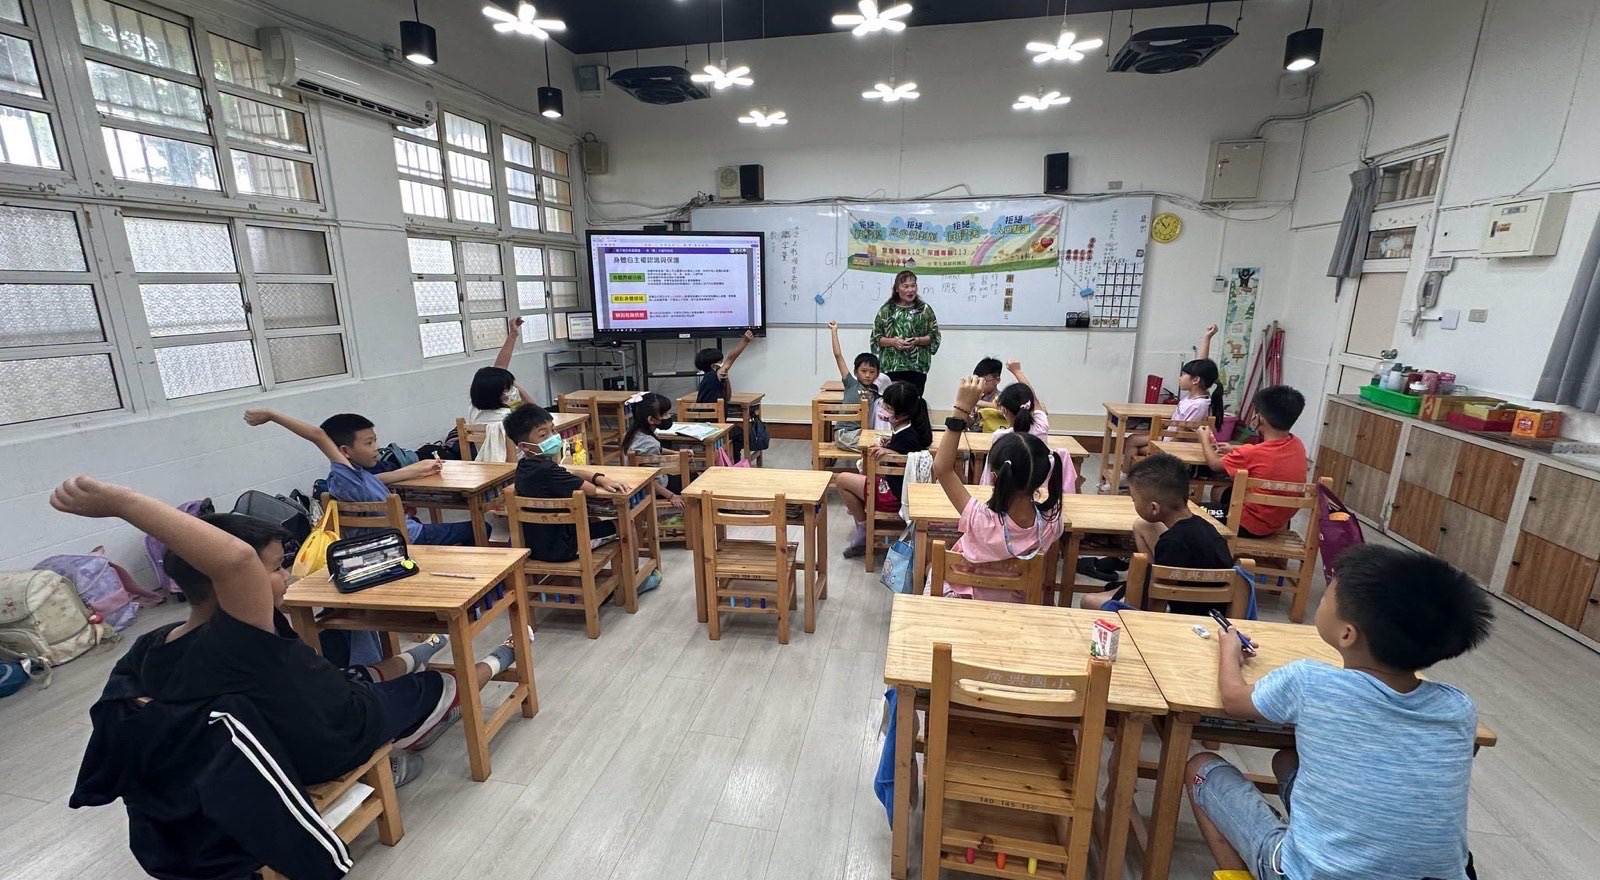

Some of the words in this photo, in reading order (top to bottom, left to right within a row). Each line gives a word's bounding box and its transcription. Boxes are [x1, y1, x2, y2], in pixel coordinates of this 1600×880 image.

[859, 221, 875, 229] 拒絕
[907, 221, 923, 230] 拒絕
[953, 220, 970, 230] 拒絕
[1005, 215, 1023, 224] 拒絕
[927, 248, 967, 257] 保護專線113
[980, 796, 994, 804] 140
